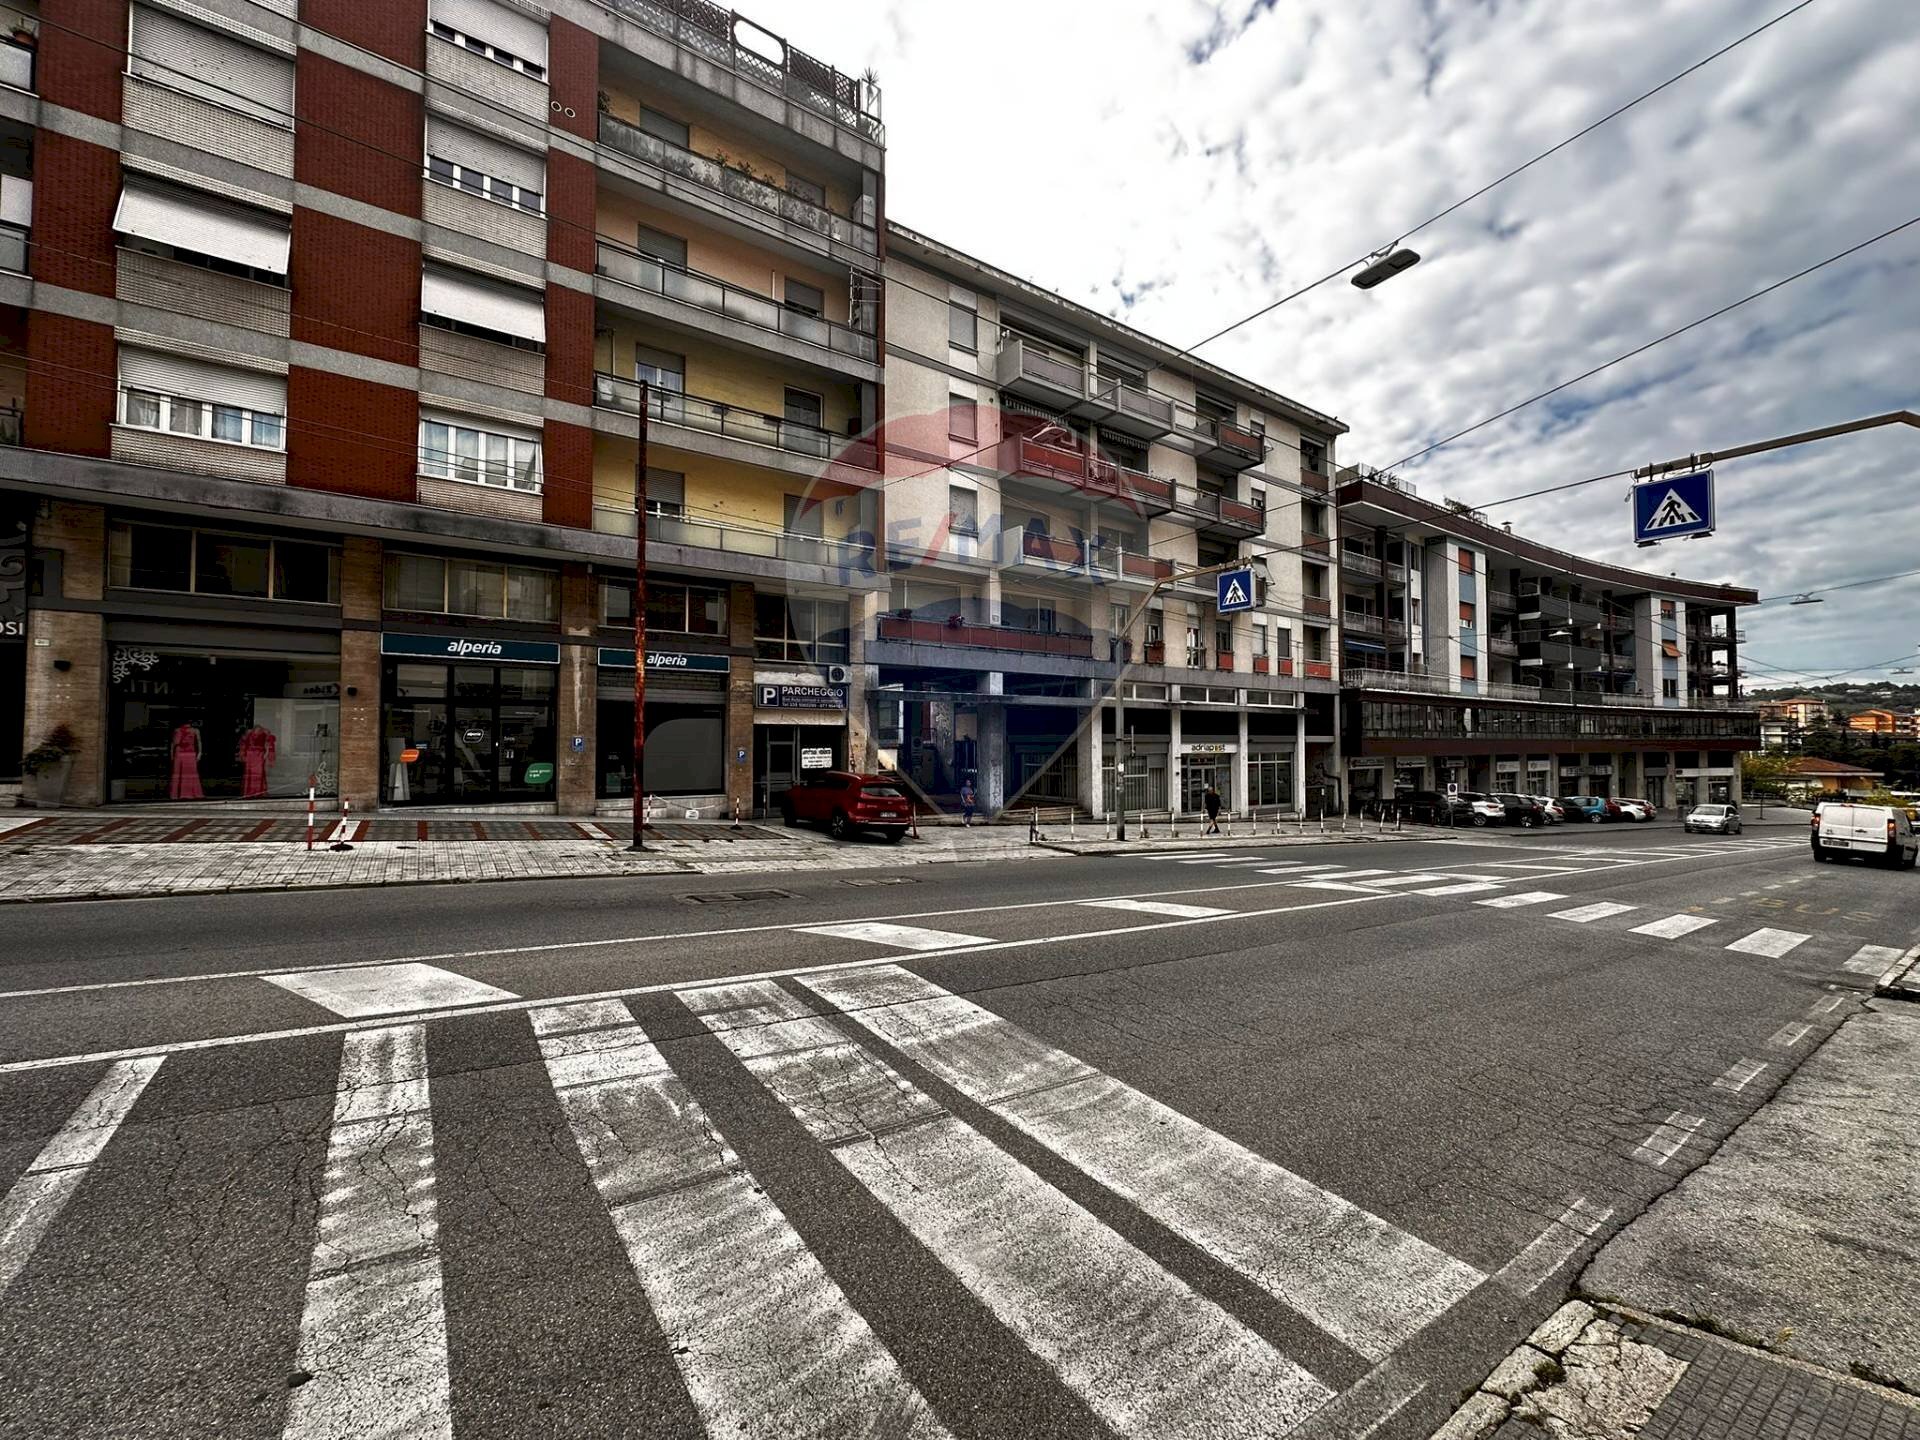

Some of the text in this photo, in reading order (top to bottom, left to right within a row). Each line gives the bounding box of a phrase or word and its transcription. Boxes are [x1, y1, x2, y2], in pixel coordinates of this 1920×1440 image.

[447, 639, 502, 655] alperia
[646, 653, 688, 667] alperia
[763, 687, 776, 704] P
[781, 686, 843, 697] PARCHEGGIO
[575, 738, 582, 746] P
